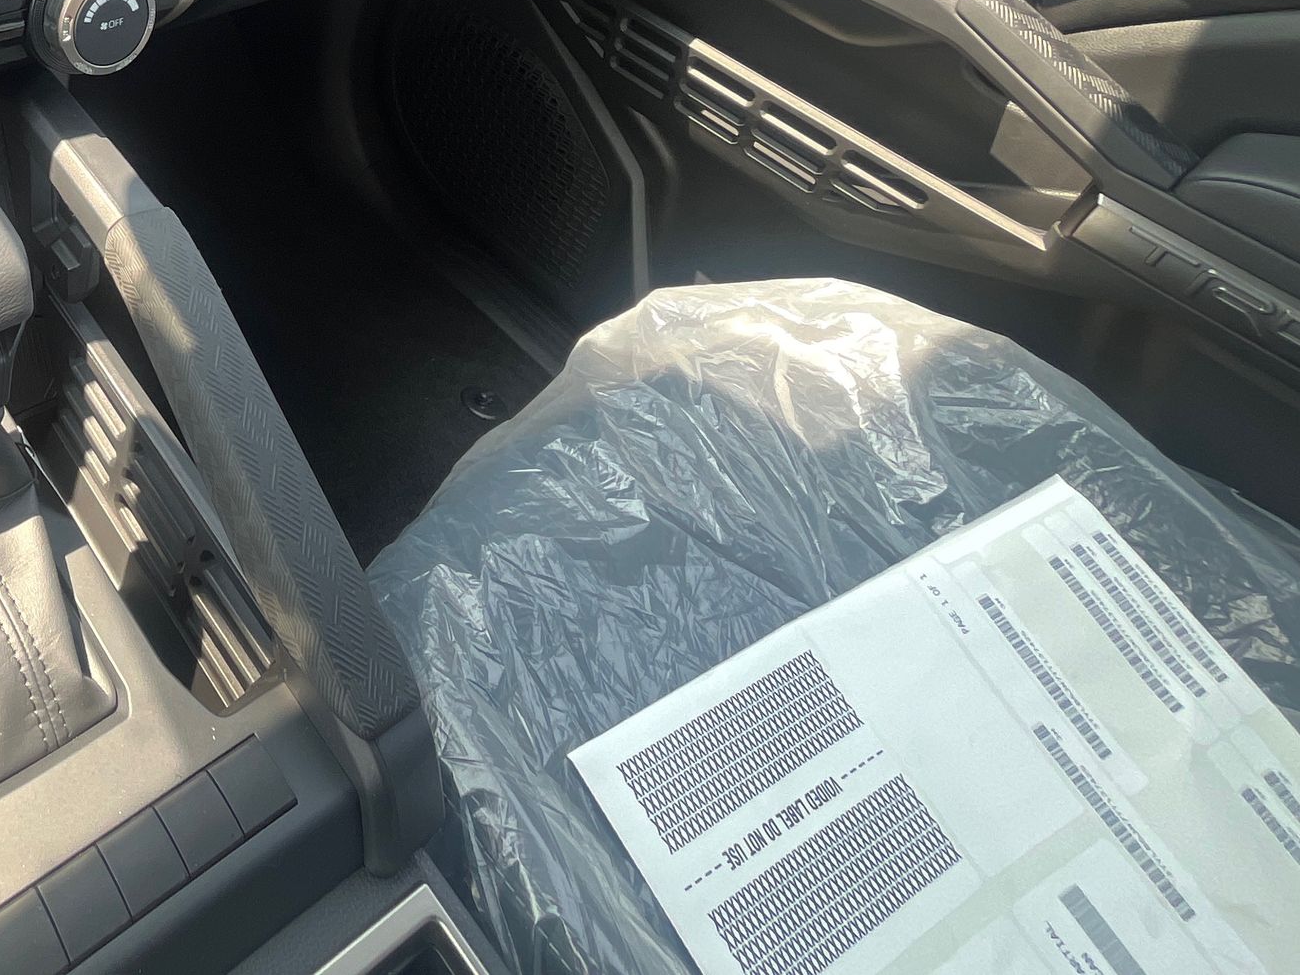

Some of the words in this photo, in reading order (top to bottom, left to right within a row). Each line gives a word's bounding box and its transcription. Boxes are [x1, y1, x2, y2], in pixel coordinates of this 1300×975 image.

[108, 16, 124, 29] OFF
[927, 585, 941, 596] OF
[948, 609, 970, 635] PAGE
[804, 776, 844, 811] VOIDED
[775, 798, 811, 830] LABEL
[743, 828, 768, 857] NOT
[761, 818, 783, 842] DO
[721, 843, 749, 871] USE
